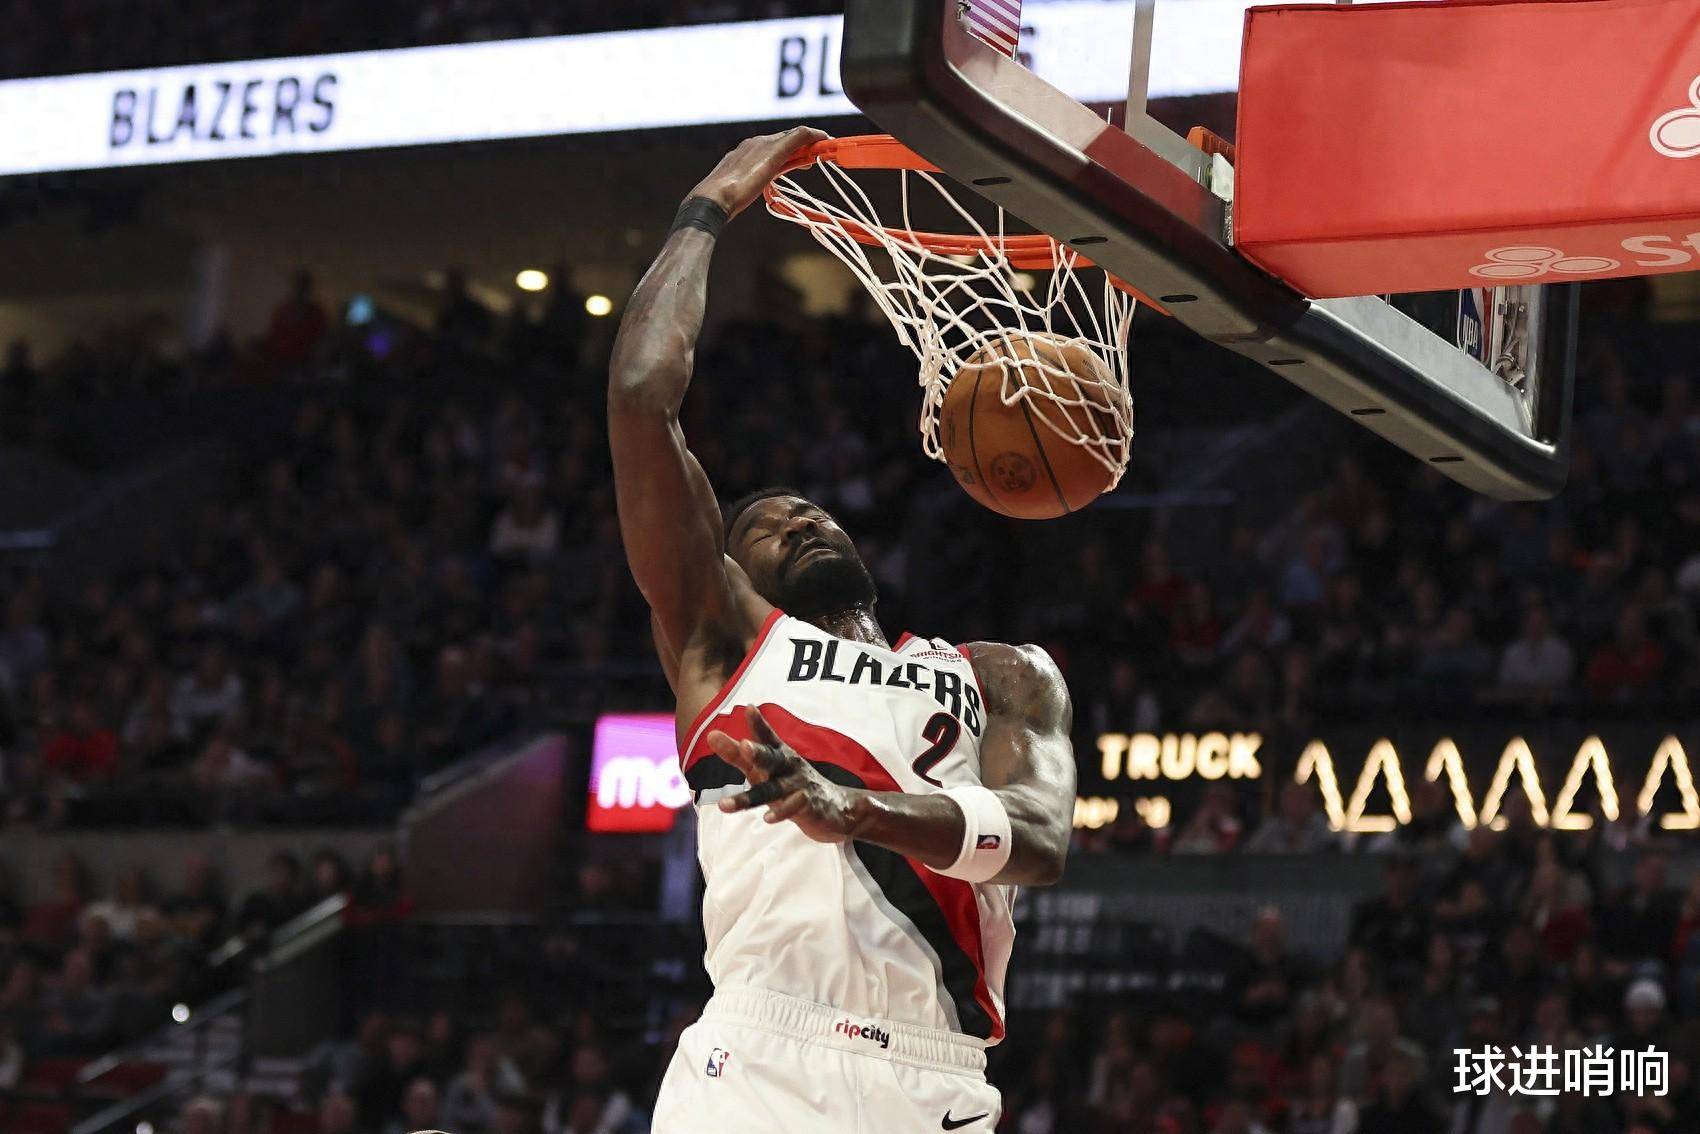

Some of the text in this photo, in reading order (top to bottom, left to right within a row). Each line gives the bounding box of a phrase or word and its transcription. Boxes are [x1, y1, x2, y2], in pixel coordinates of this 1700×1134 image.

[109, 73, 338, 148] BLAZERS
[787, 638, 981, 738] BLAZERS
[912, 712, 961, 788] 2
[1097, 731, 1263, 781] TRUCK
